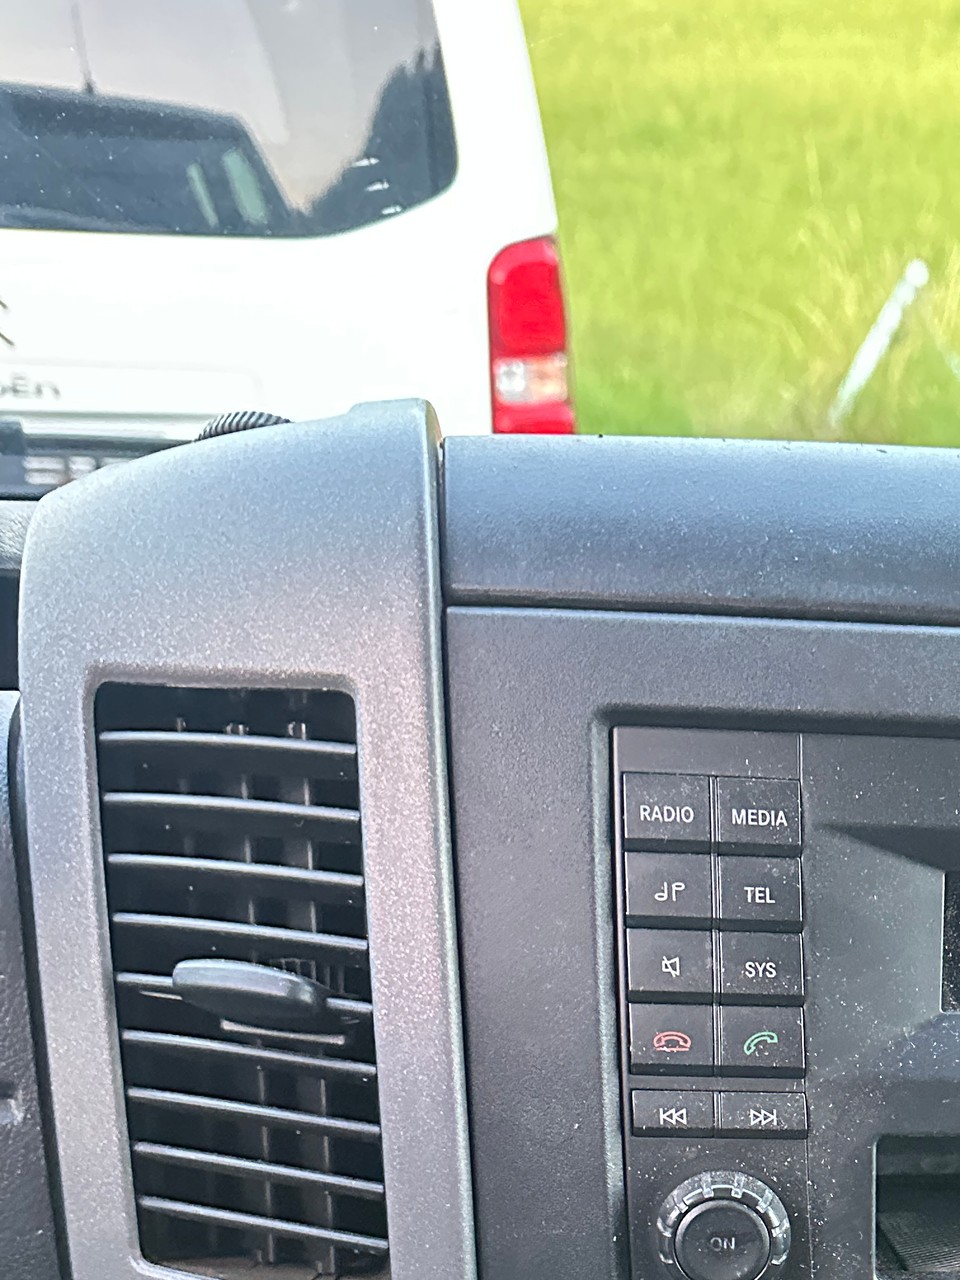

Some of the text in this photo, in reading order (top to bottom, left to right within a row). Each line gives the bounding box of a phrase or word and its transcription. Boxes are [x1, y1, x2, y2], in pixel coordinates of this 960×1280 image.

[639, 805, 788, 828] RADIO MEDIA
[744, 886, 776, 905] TEL
[745, 962, 777, 979] SYS
[710, 1236, 736, 1252] ON
